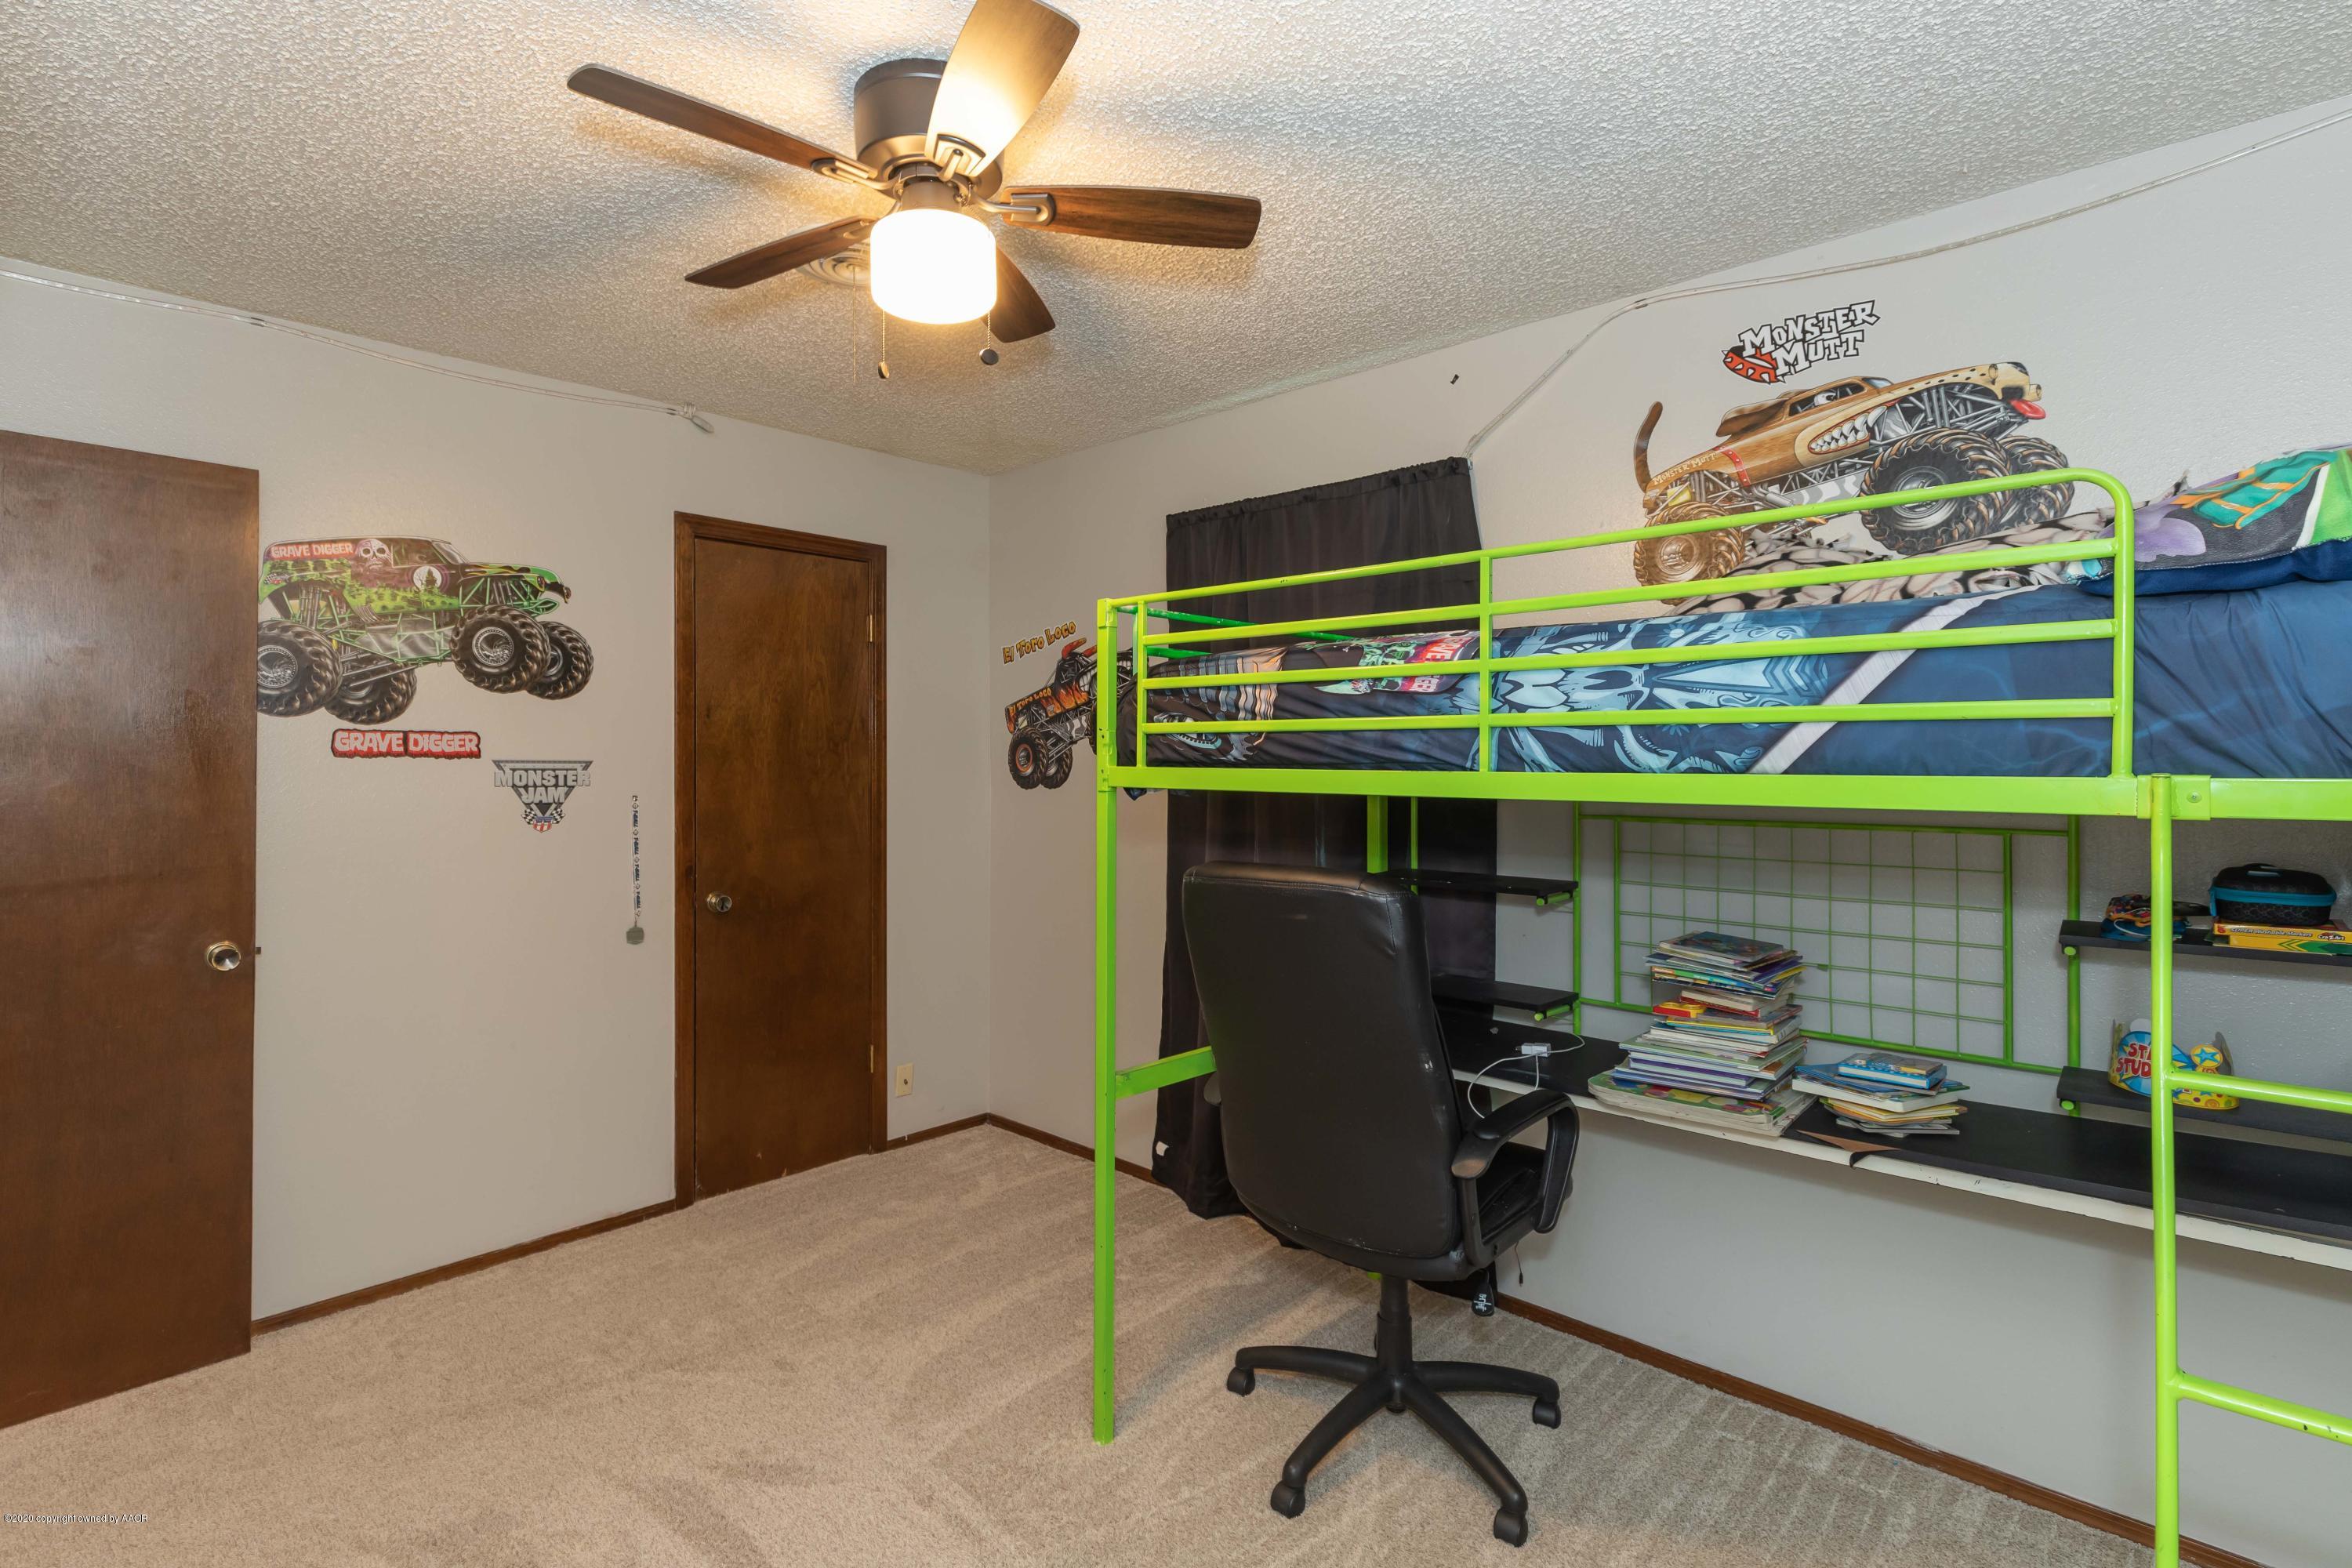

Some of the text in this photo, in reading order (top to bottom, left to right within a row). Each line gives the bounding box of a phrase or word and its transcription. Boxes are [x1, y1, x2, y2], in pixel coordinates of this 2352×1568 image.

[1738, 299, 1881, 356] MONSTER
[1772, 329, 1864, 376] MUTT
[270, 543, 353, 558] GRAVE DIGGER
[334, 731, 478, 752] GRAVE DIGGER
[495, 770, 590, 787] MONSTER
[519, 786, 568, 804] JAM
[2128, 1042, 2151, 1060] ST
[2116, 1057, 2151, 1078] STUD
